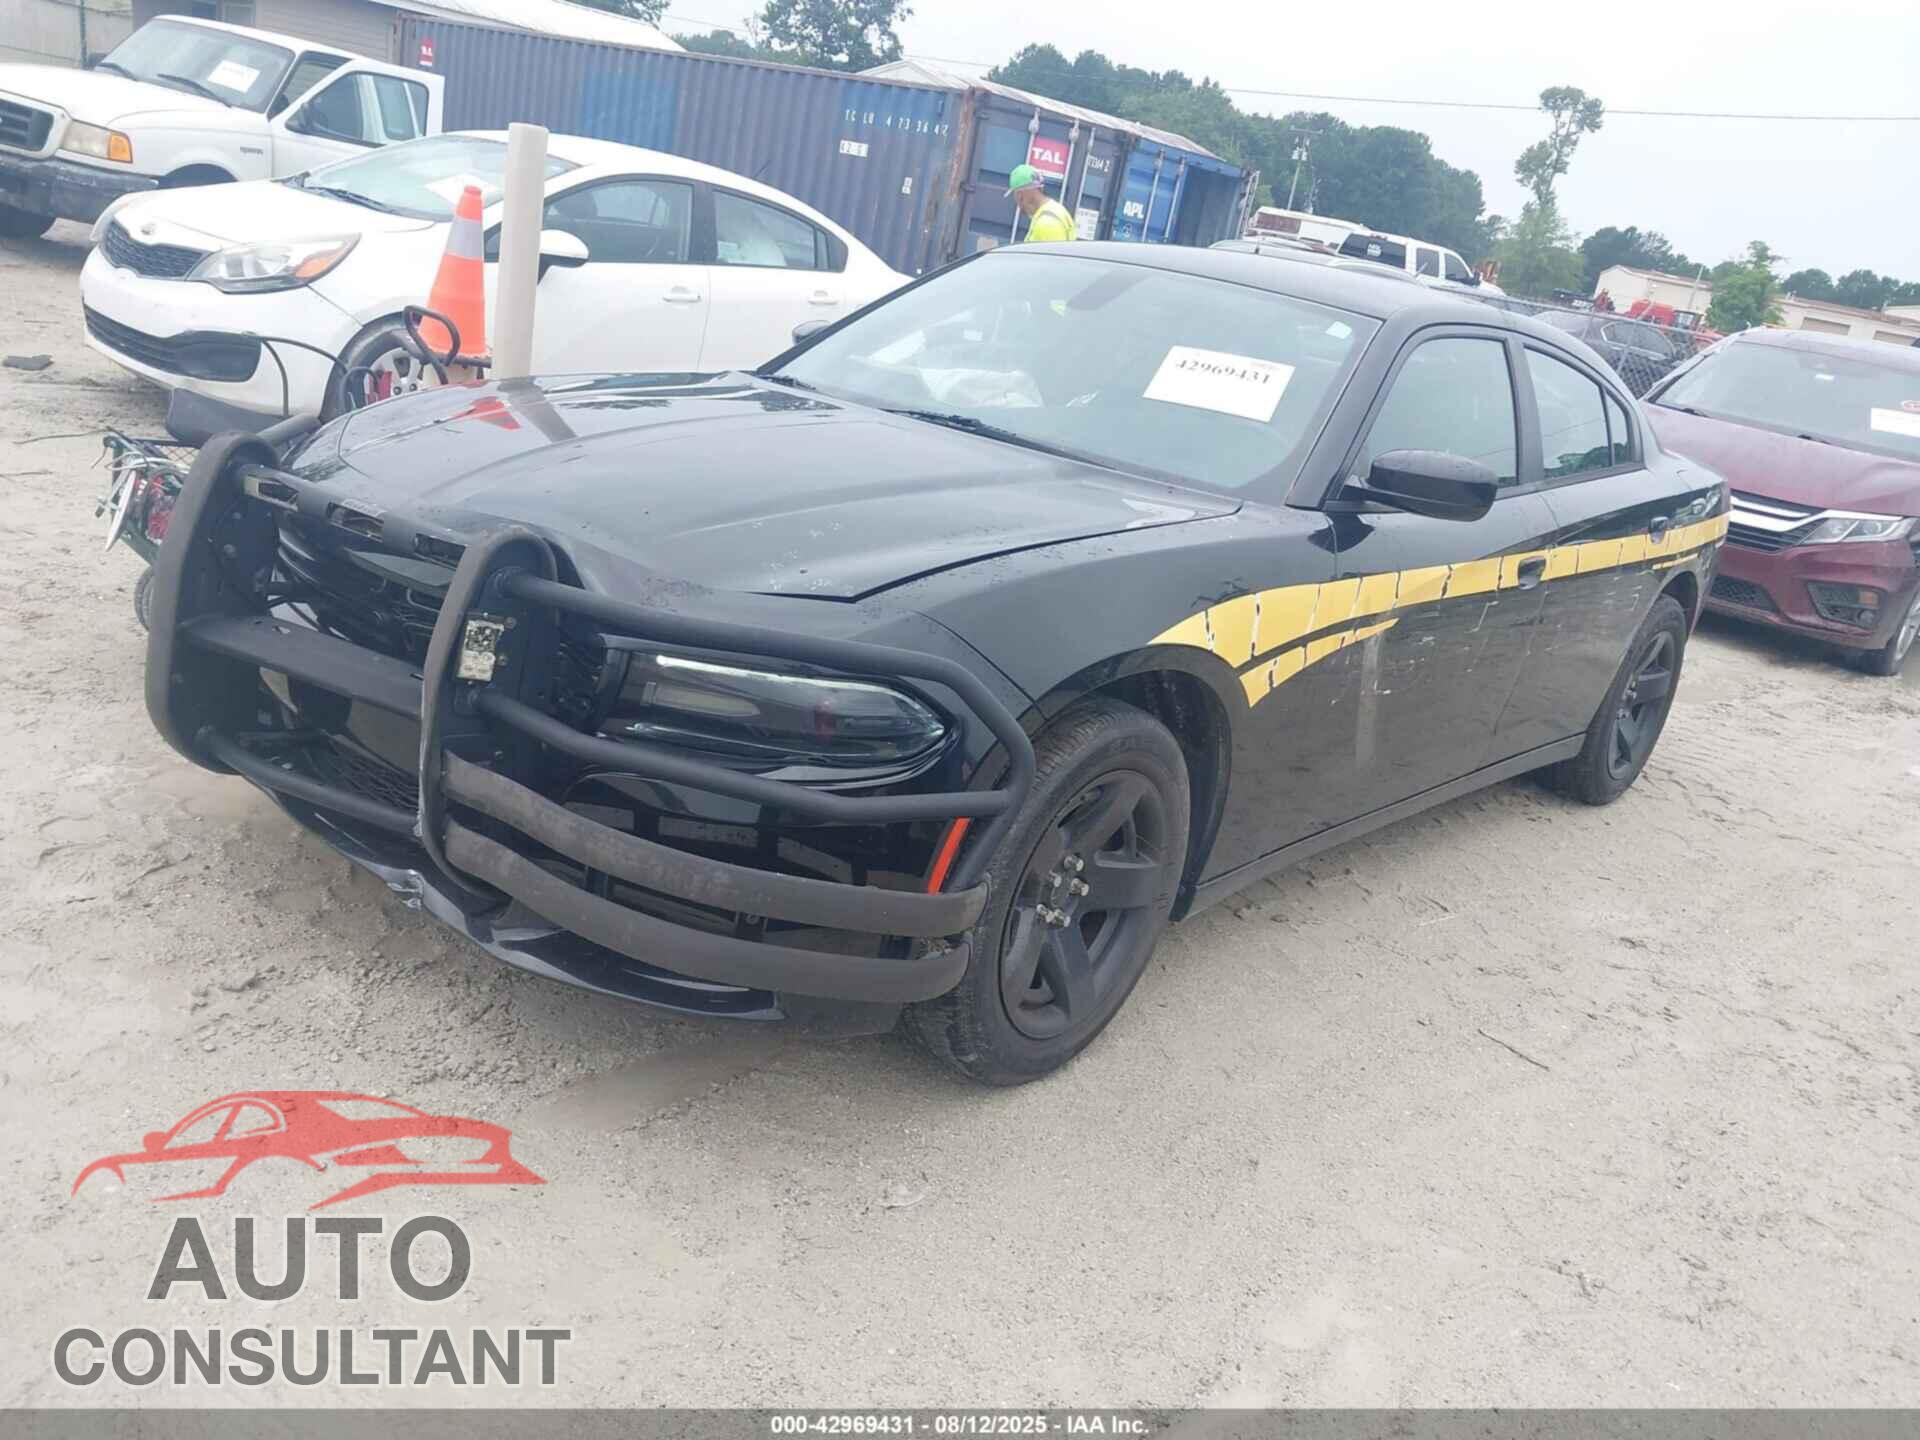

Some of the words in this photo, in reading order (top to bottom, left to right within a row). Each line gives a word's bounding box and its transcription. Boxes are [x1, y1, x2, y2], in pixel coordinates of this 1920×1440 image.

[1031, 147, 1065, 165] TAL
[1123, 200, 1144, 219] APL
[1175, 359, 1271, 385] 42969431
